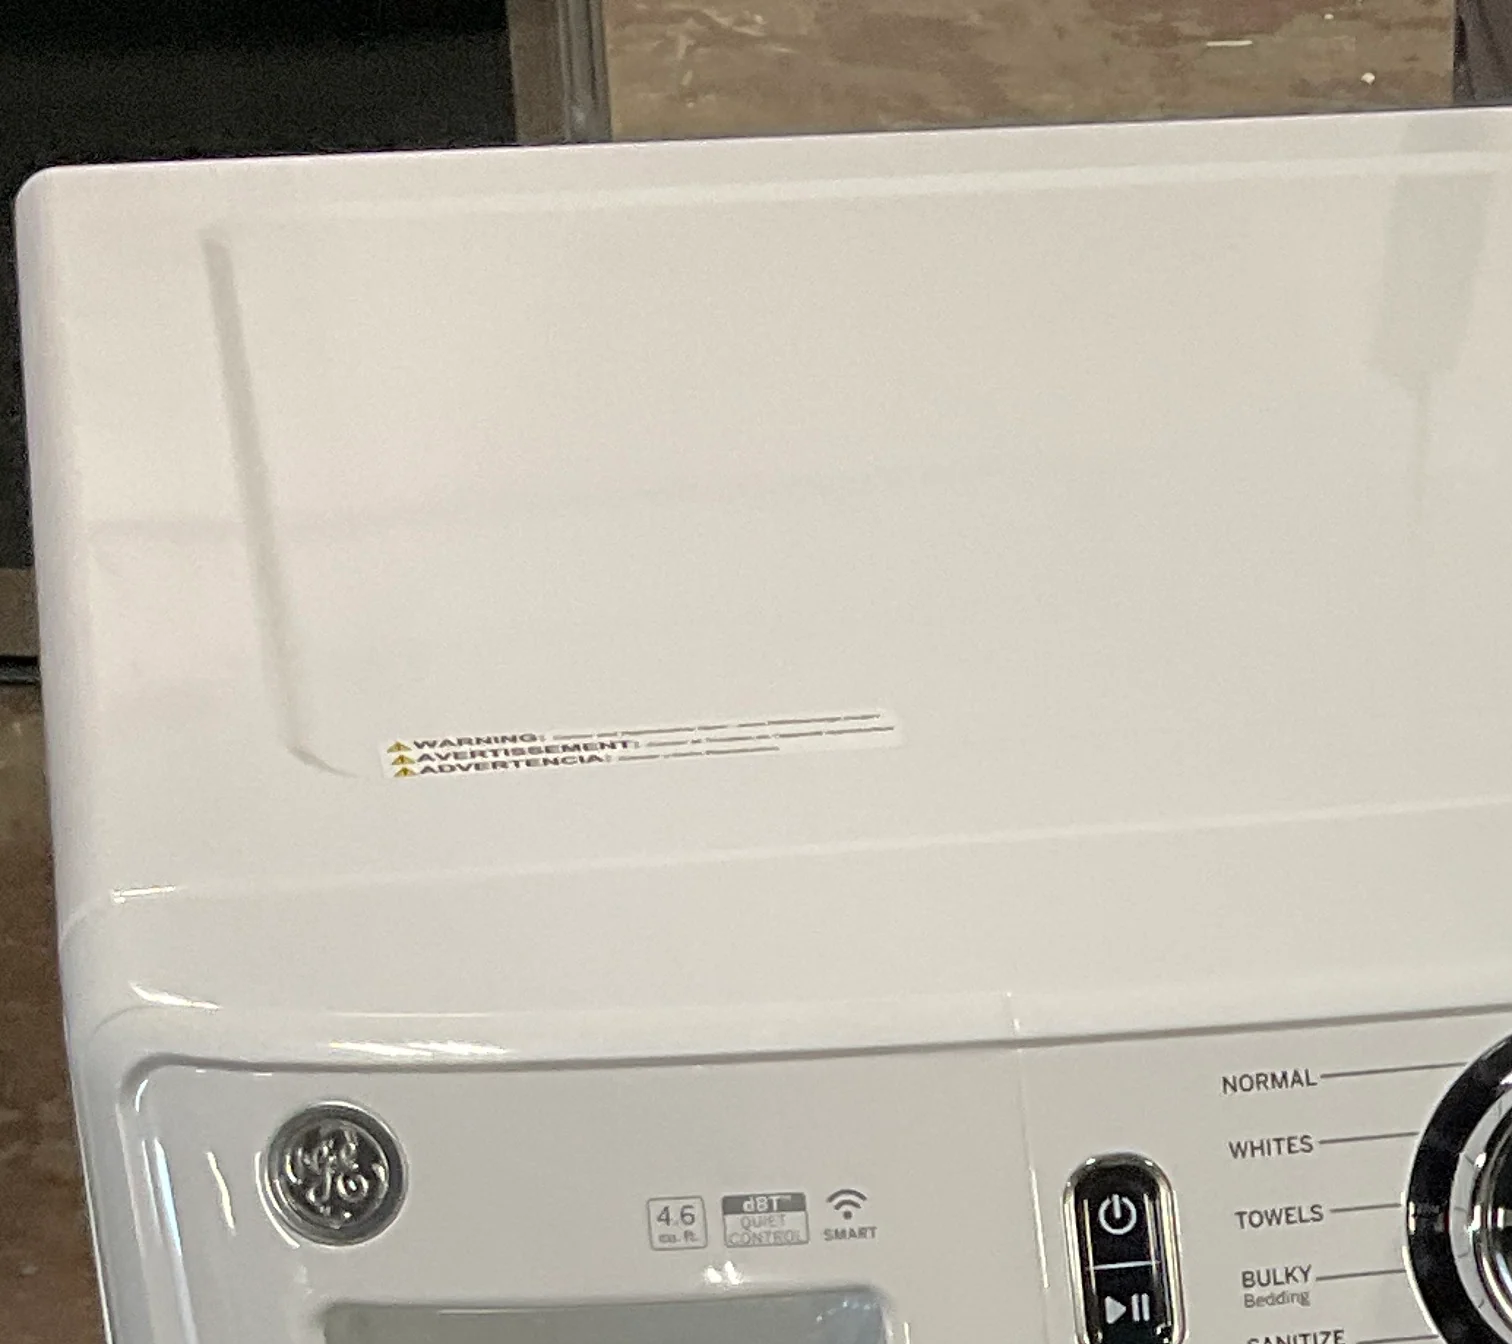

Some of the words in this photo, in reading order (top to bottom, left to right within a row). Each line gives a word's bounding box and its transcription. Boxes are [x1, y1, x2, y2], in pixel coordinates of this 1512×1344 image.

[1221, 1068, 1319, 1095] NORMAL
[1227, 1134, 1314, 1160] WHITES
[1234, 1204, 1324, 1230] TOWELS
[822, 1225, 878, 1242] SMART
[1241, 1264, 1313, 1289] BULKY
[1243, 1290, 1312, 1309] Bedding
